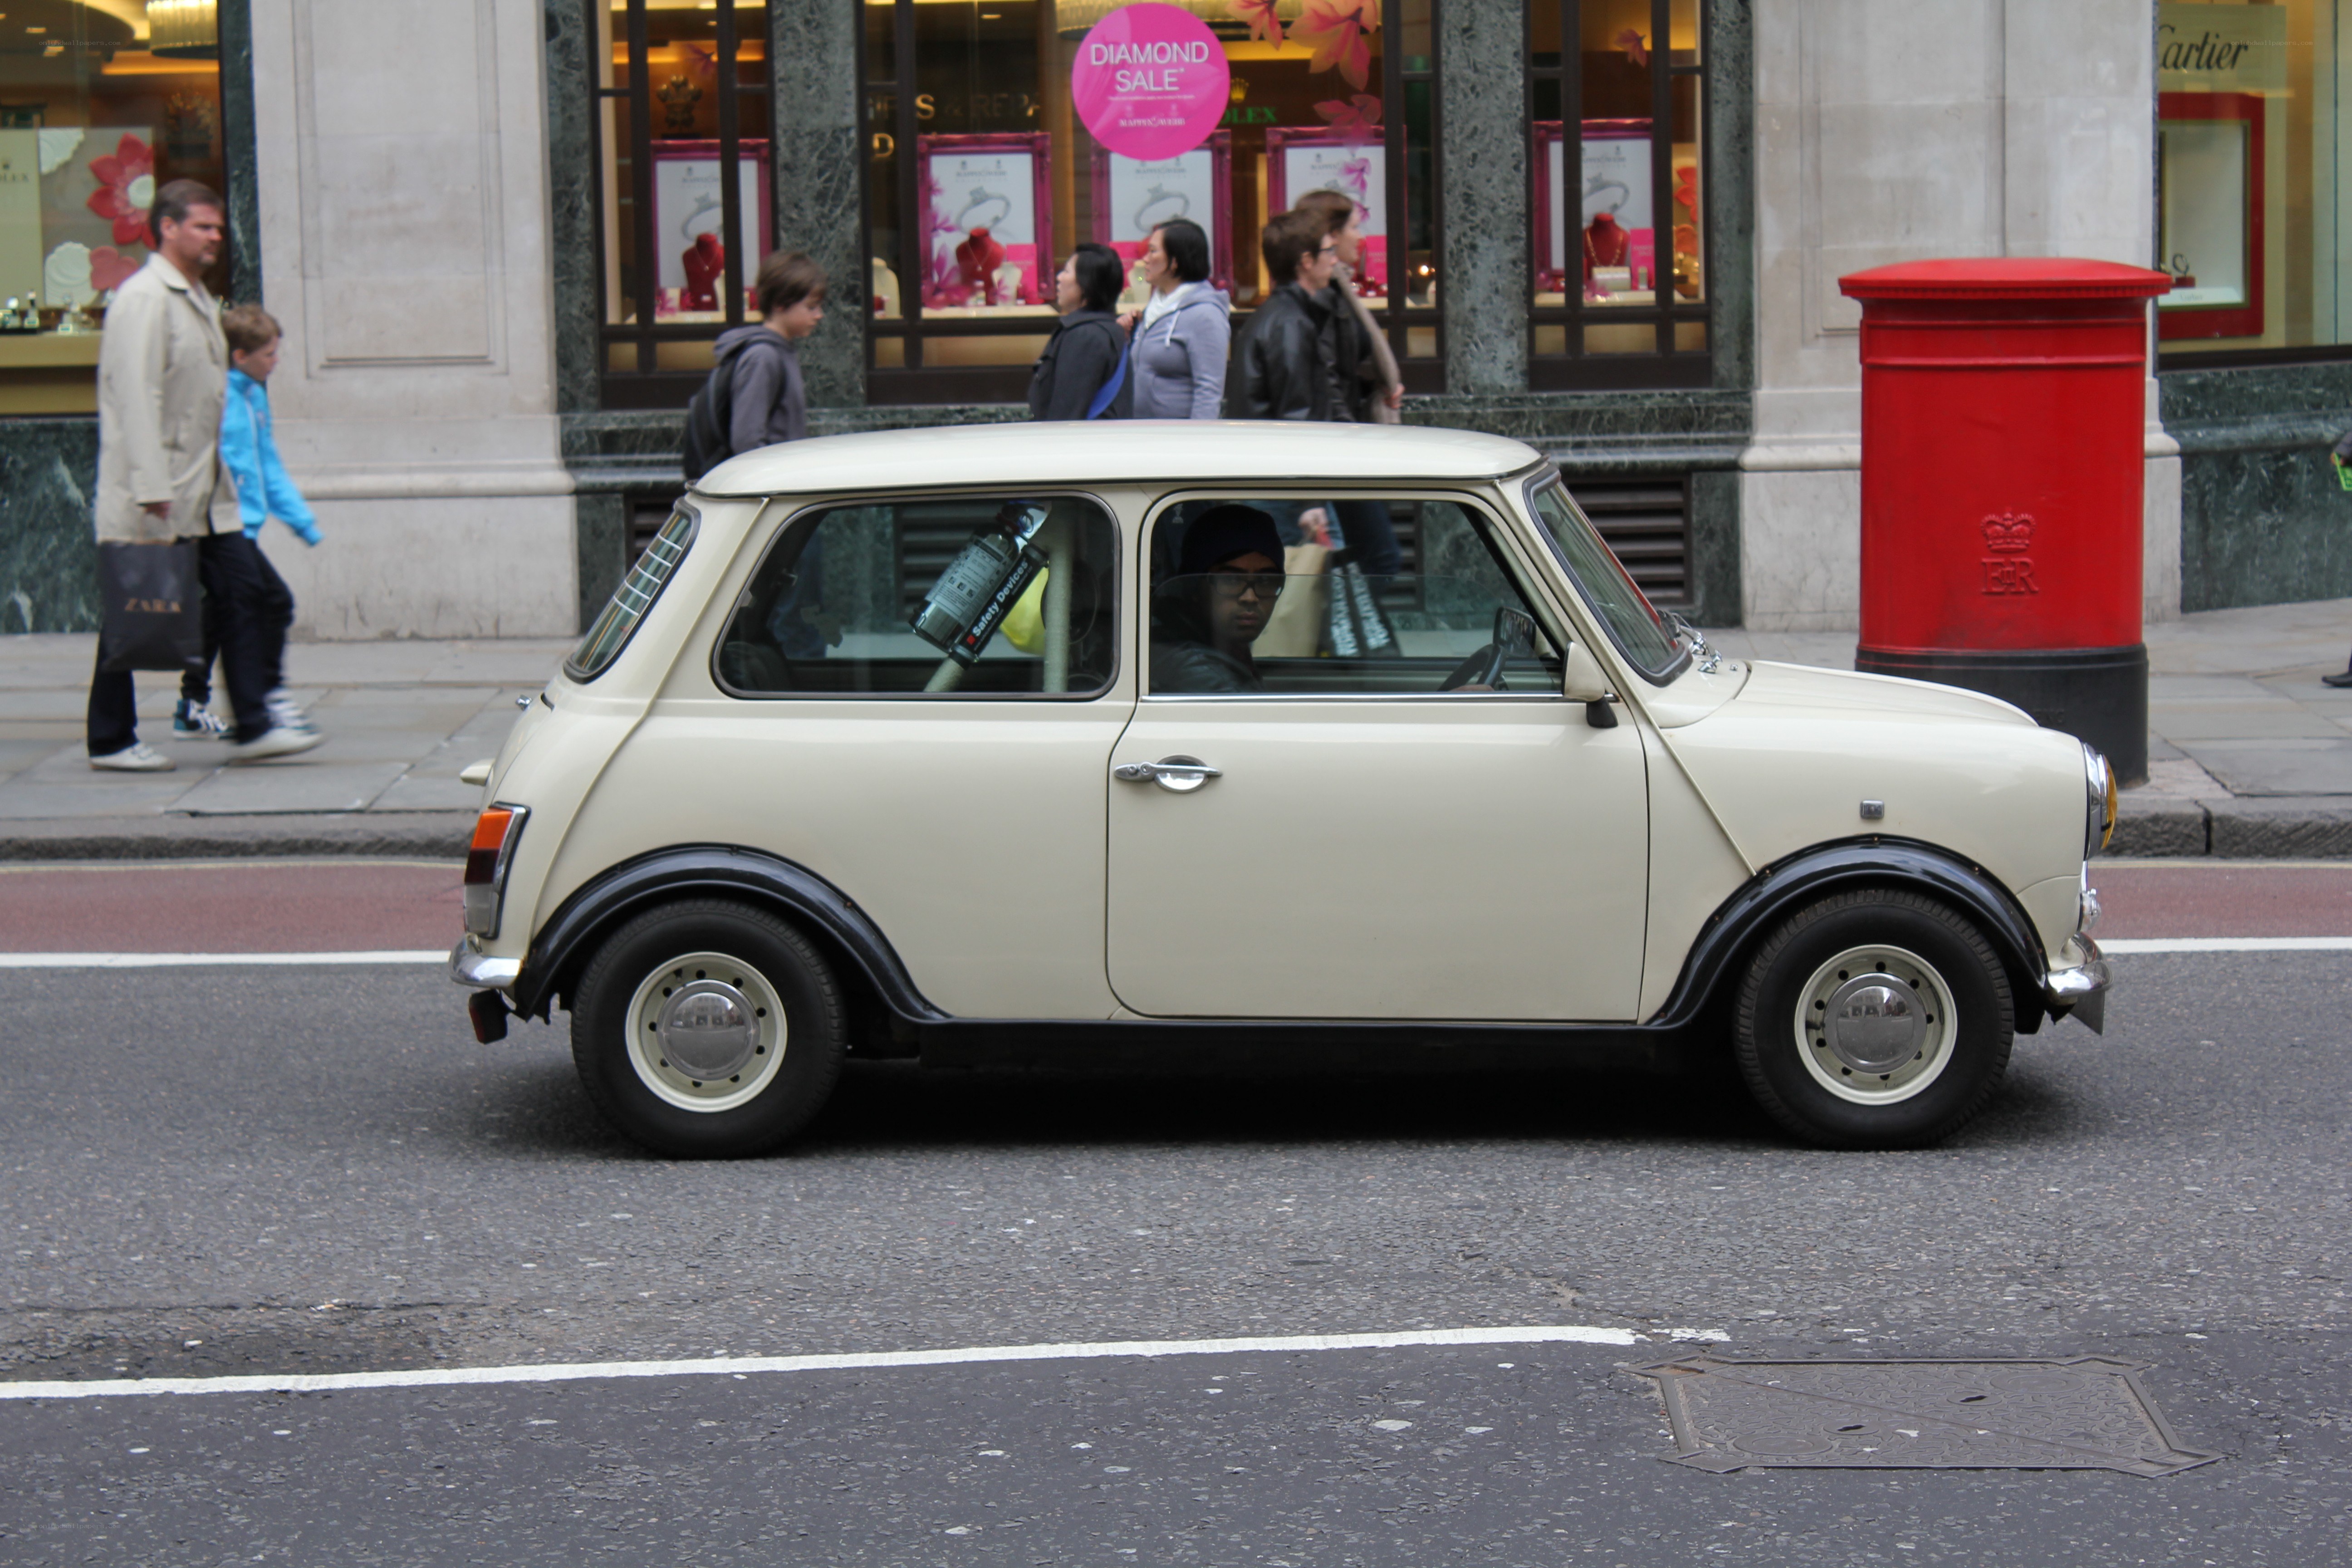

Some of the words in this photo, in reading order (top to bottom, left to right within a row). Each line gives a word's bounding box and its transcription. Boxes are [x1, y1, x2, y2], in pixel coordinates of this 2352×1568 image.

[1090, 41, 1209, 65] DIAMOND
[1220, 107, 1278, 124] OLEX
[124, 598, 182, 614] ZARA
[972, 601, 1000, 637] Safety
[996, 561, 1029, 603] Devices
